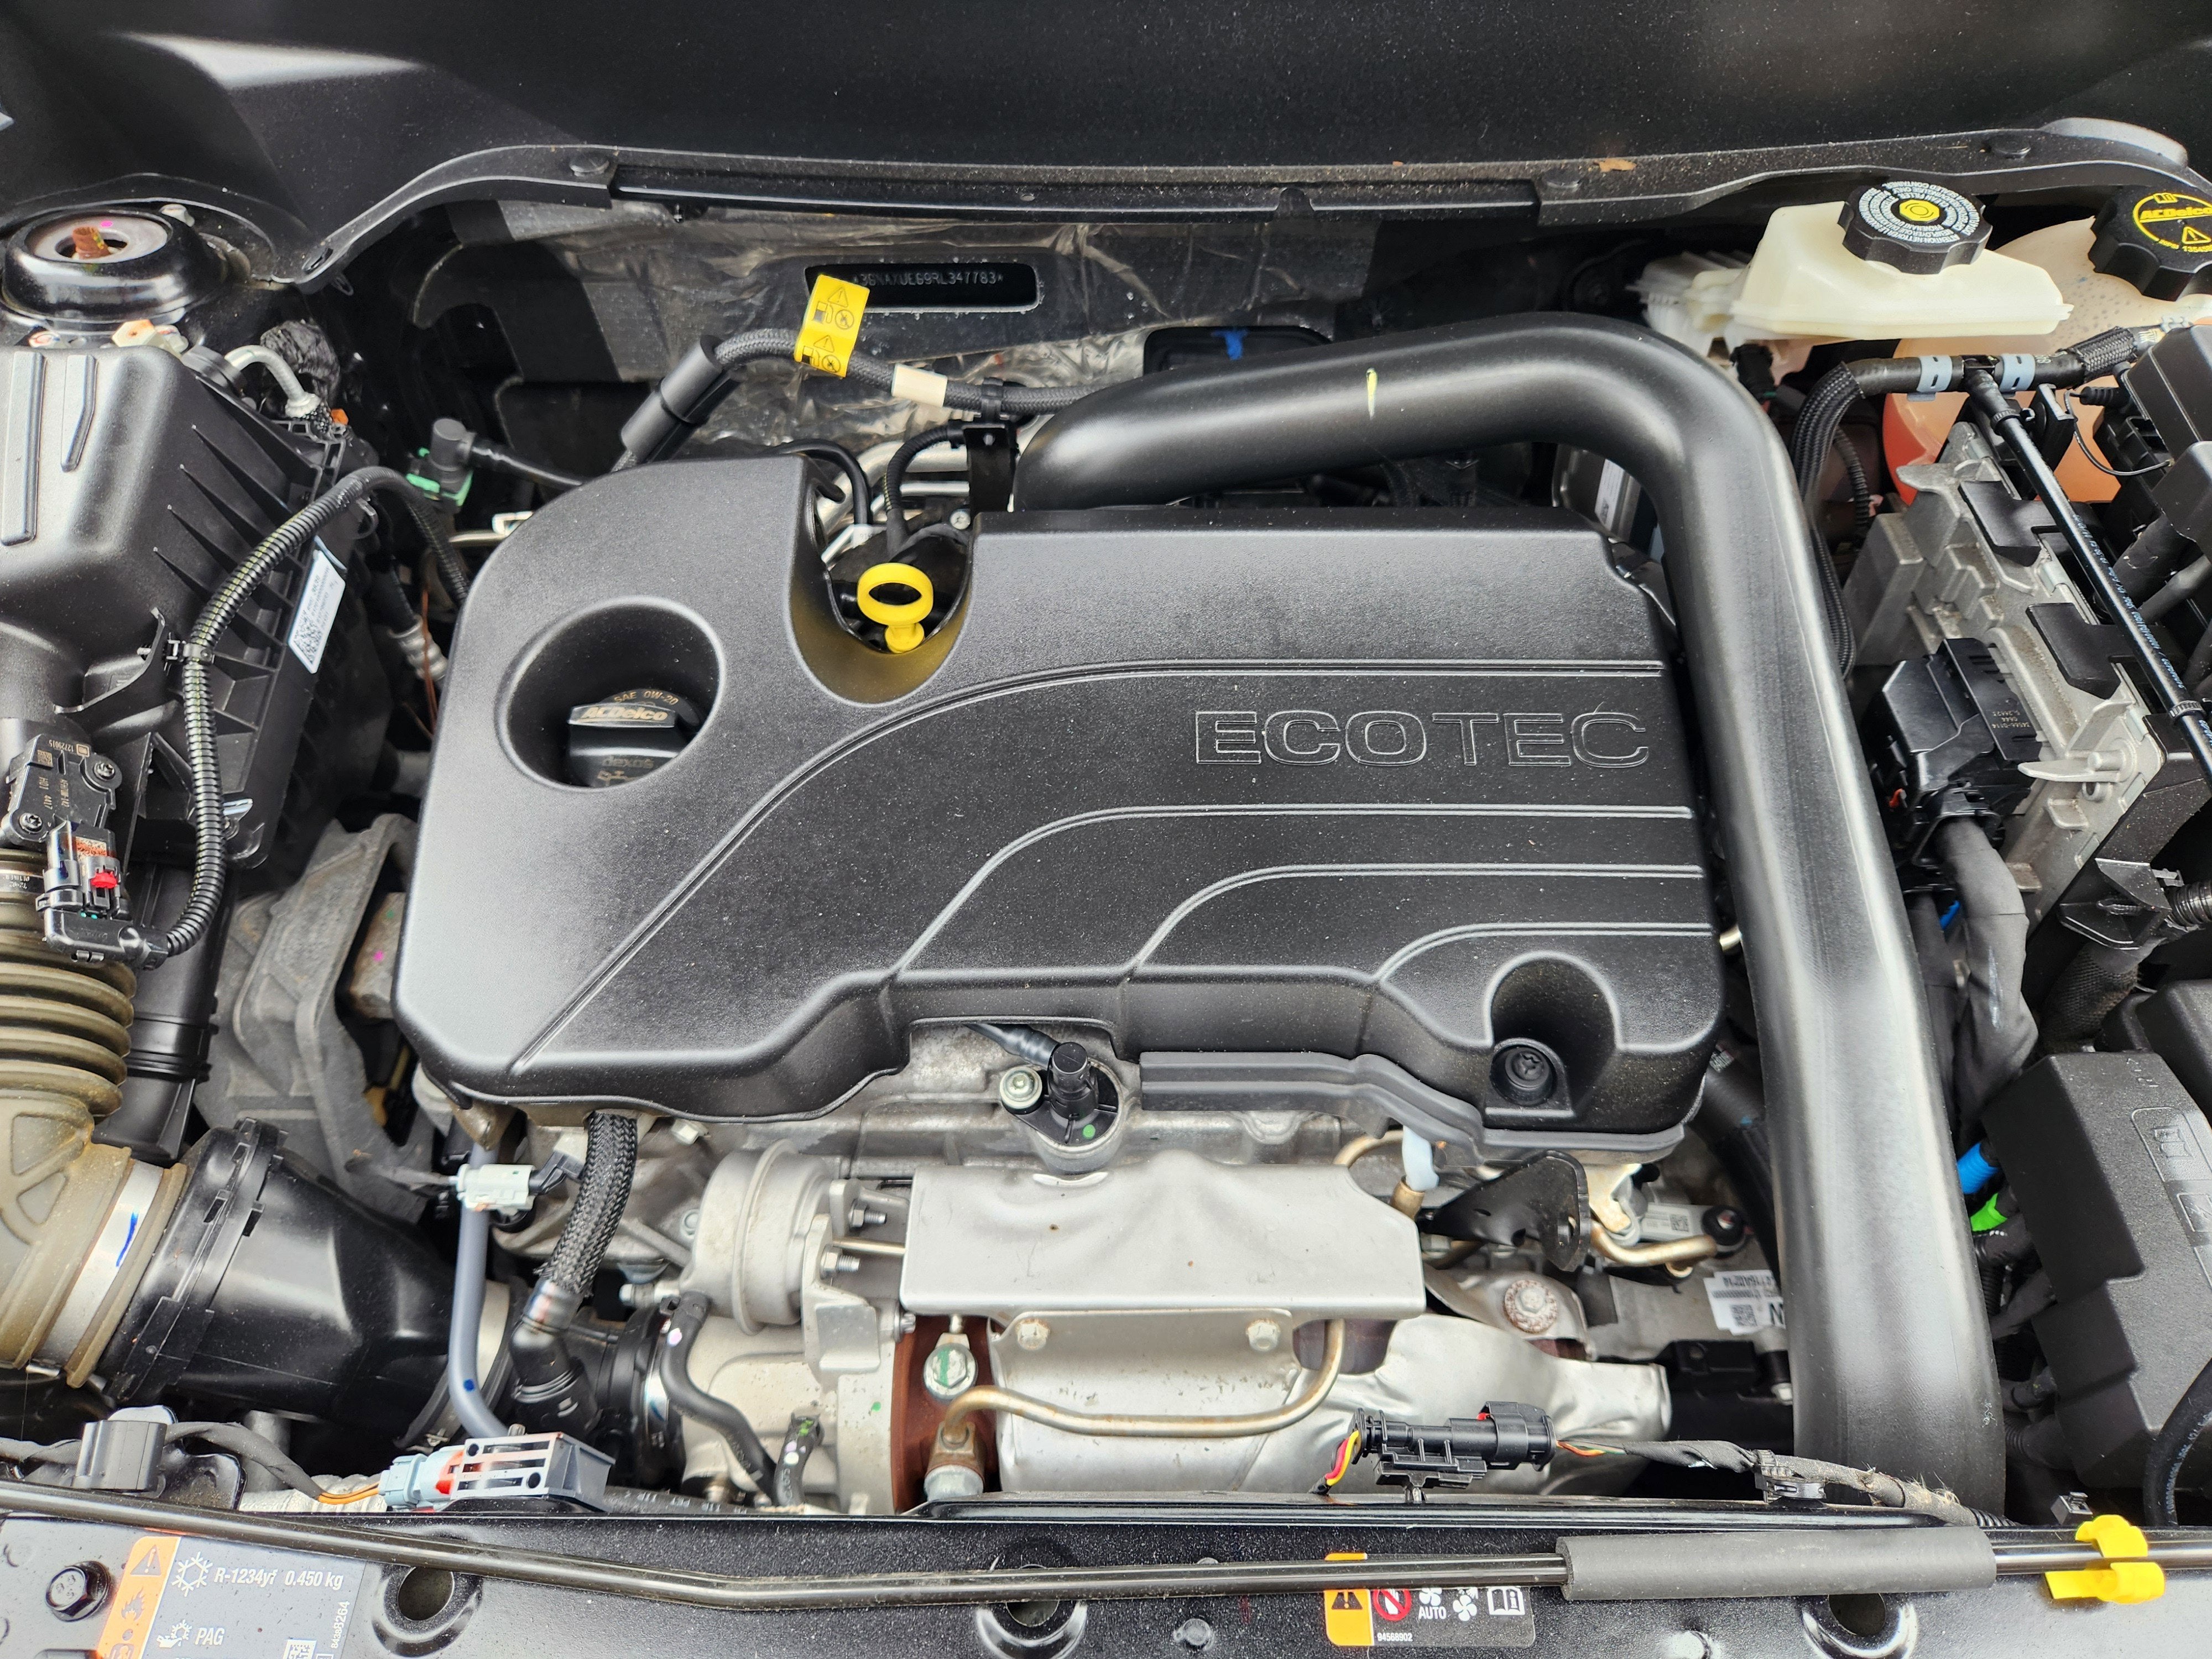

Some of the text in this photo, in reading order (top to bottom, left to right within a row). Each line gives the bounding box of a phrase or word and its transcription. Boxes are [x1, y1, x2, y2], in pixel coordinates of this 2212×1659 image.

[614, 691, 679, 705] SAE 0W-20
[581, 707, 668, 721] ACDelco
[1196, 710, 1648, 768] ECOTEC
[602, 756, 655, 768] dexos
[213, 1567, 344, 1590] R-1234yf 0.450 kg
[1418, 1606, 1447, 1620] AUTO
[331, 1600, 350, 1648] 84388264
[195, 1627, 225, 1646] PAG
[1377, 1632, 1413, 1642] 94568902
